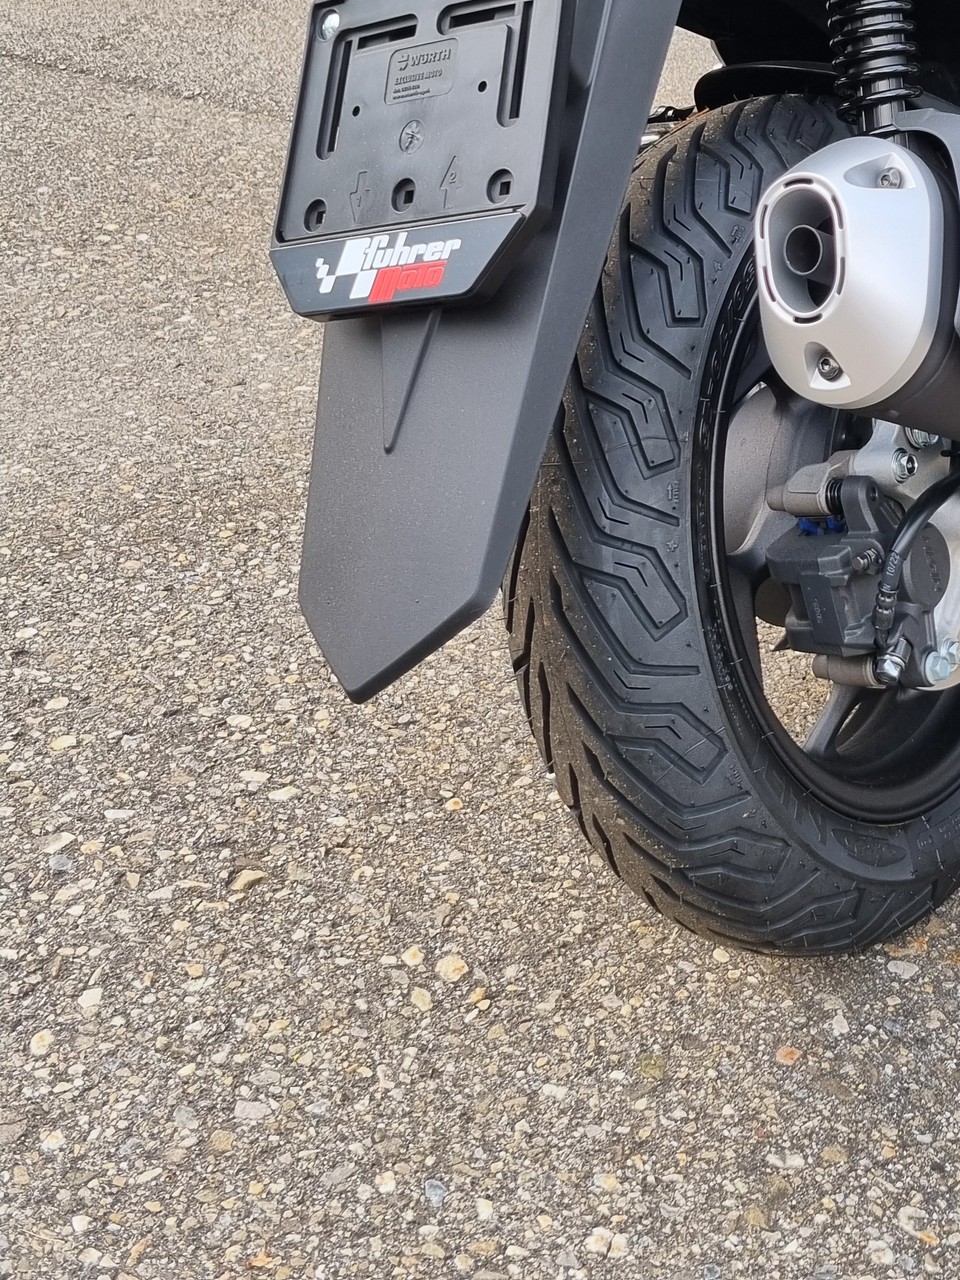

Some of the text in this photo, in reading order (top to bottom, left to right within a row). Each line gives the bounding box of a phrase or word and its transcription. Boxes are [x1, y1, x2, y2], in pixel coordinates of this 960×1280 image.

[425, 68, 443, 80] MOTO
[449, 171, 457, 185] 2
[886, 552, 900, 577] 10/22
